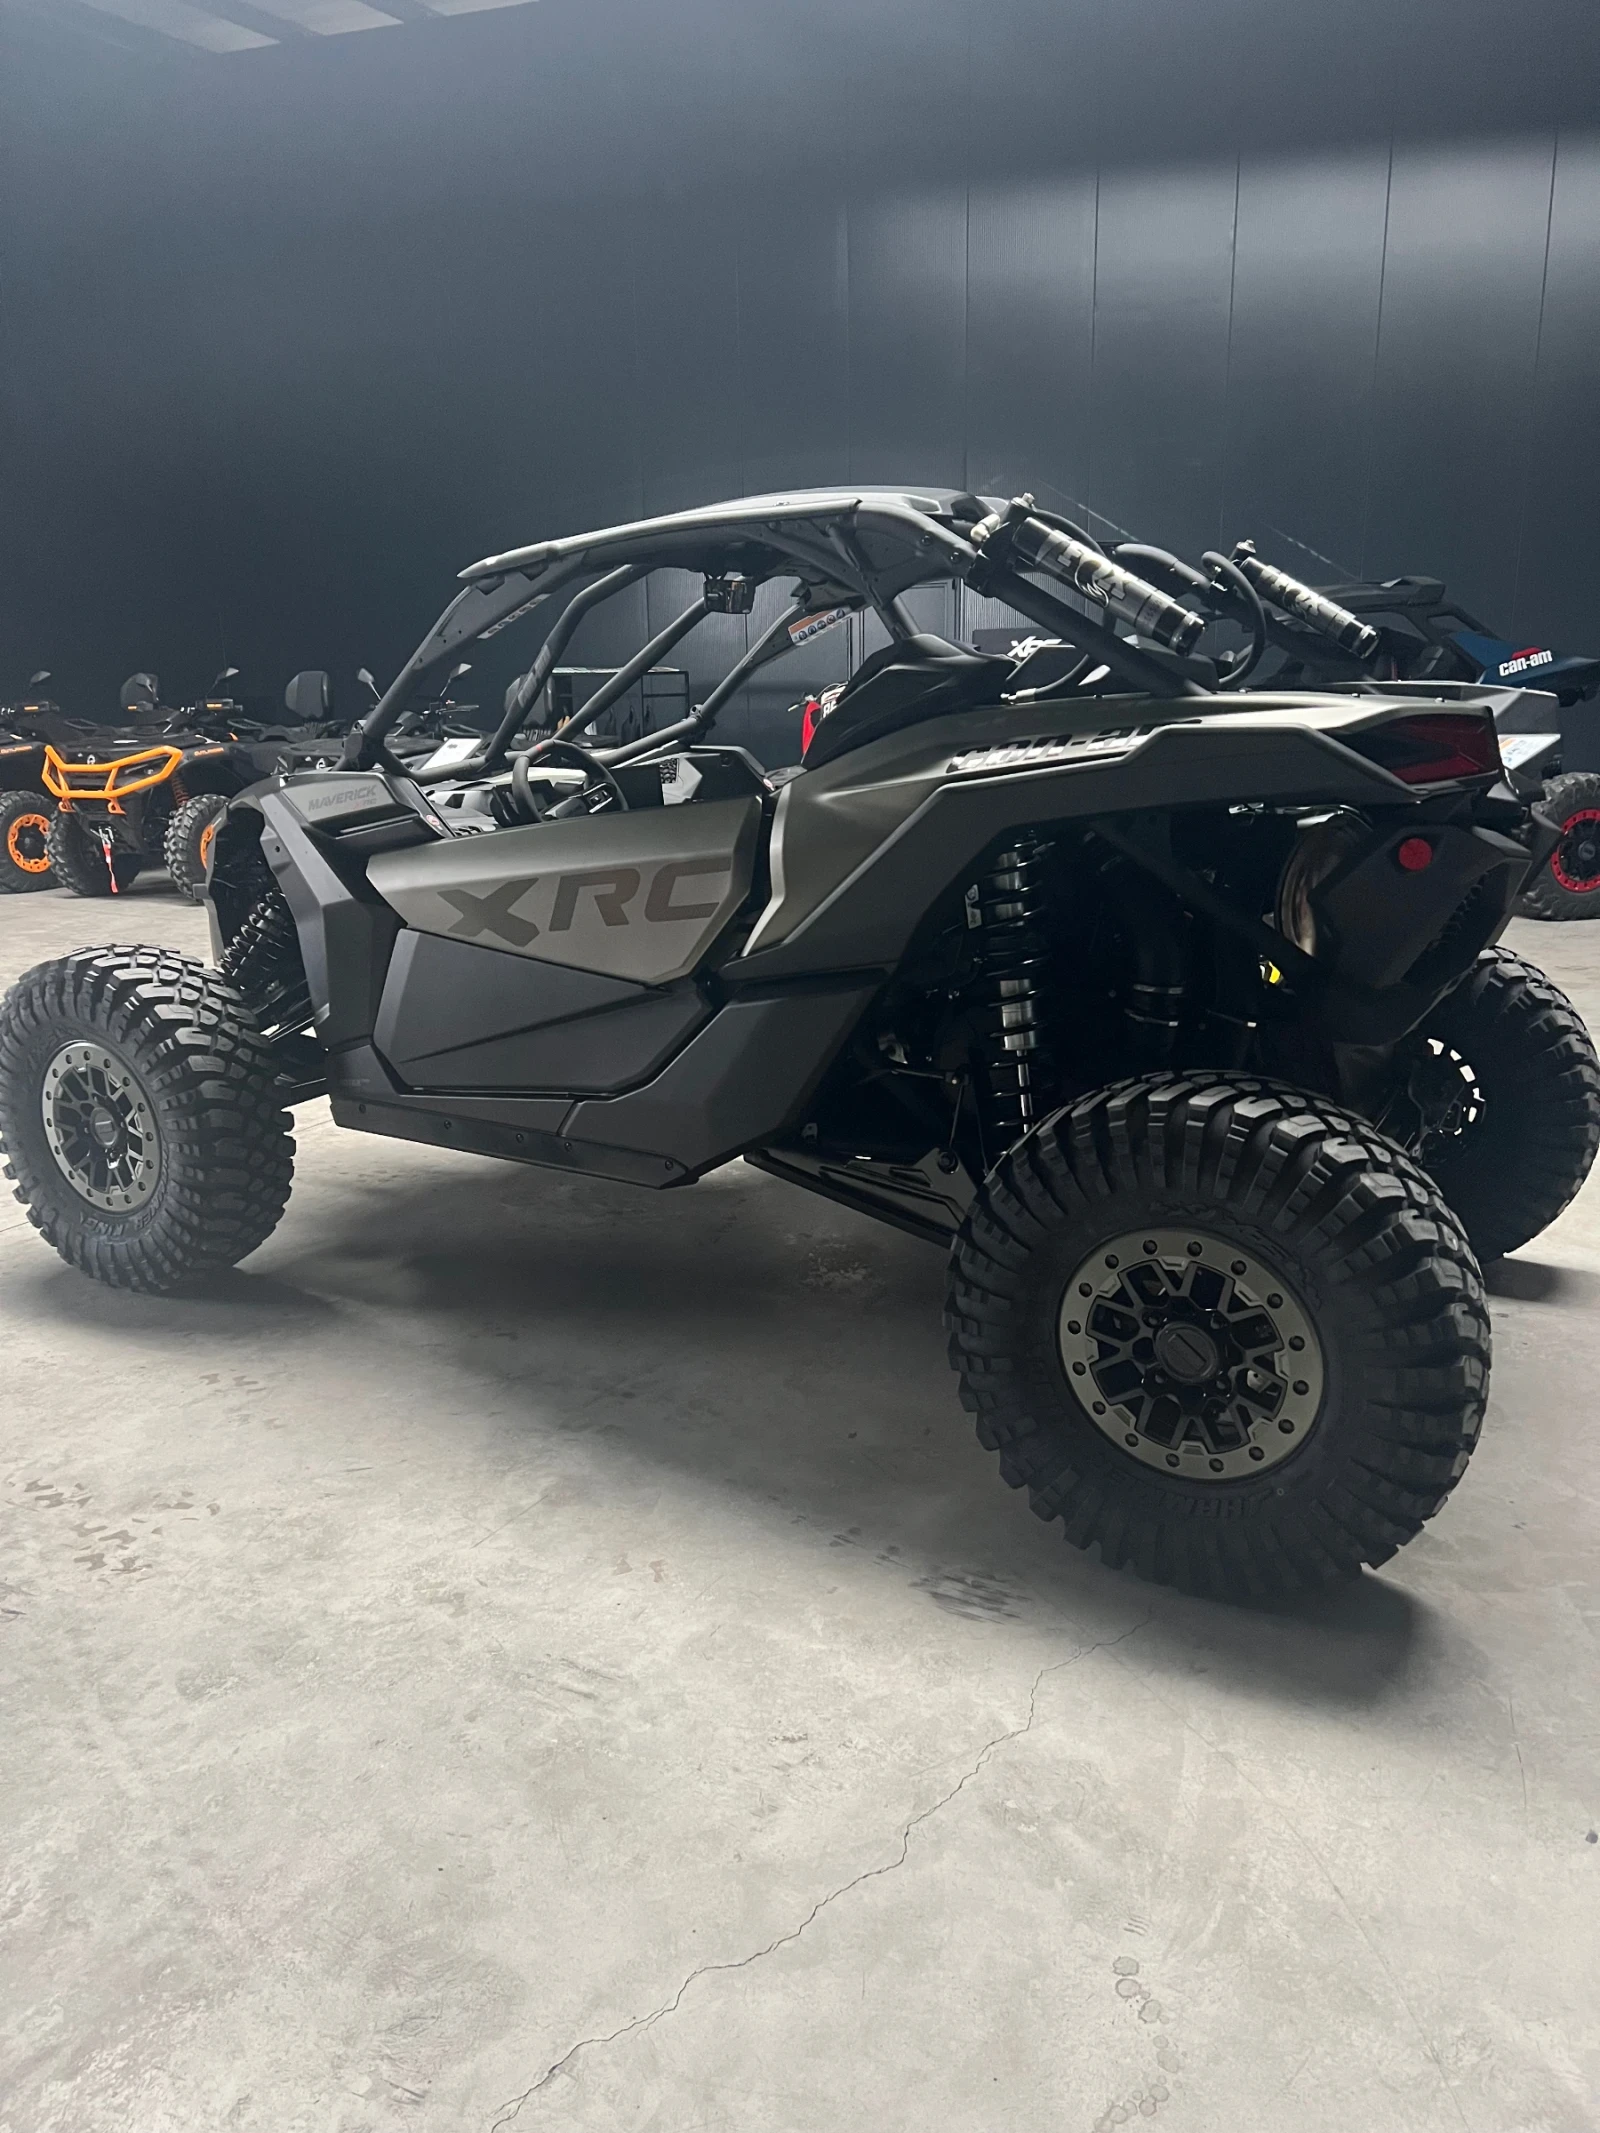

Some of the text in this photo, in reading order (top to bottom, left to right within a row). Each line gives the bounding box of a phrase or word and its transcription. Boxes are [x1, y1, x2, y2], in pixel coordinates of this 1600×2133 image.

[1498, 649, 1553, 677] can-am
[308, 784, 377, 812] MAVERICK
[437, 856, 732, 948] XRC
